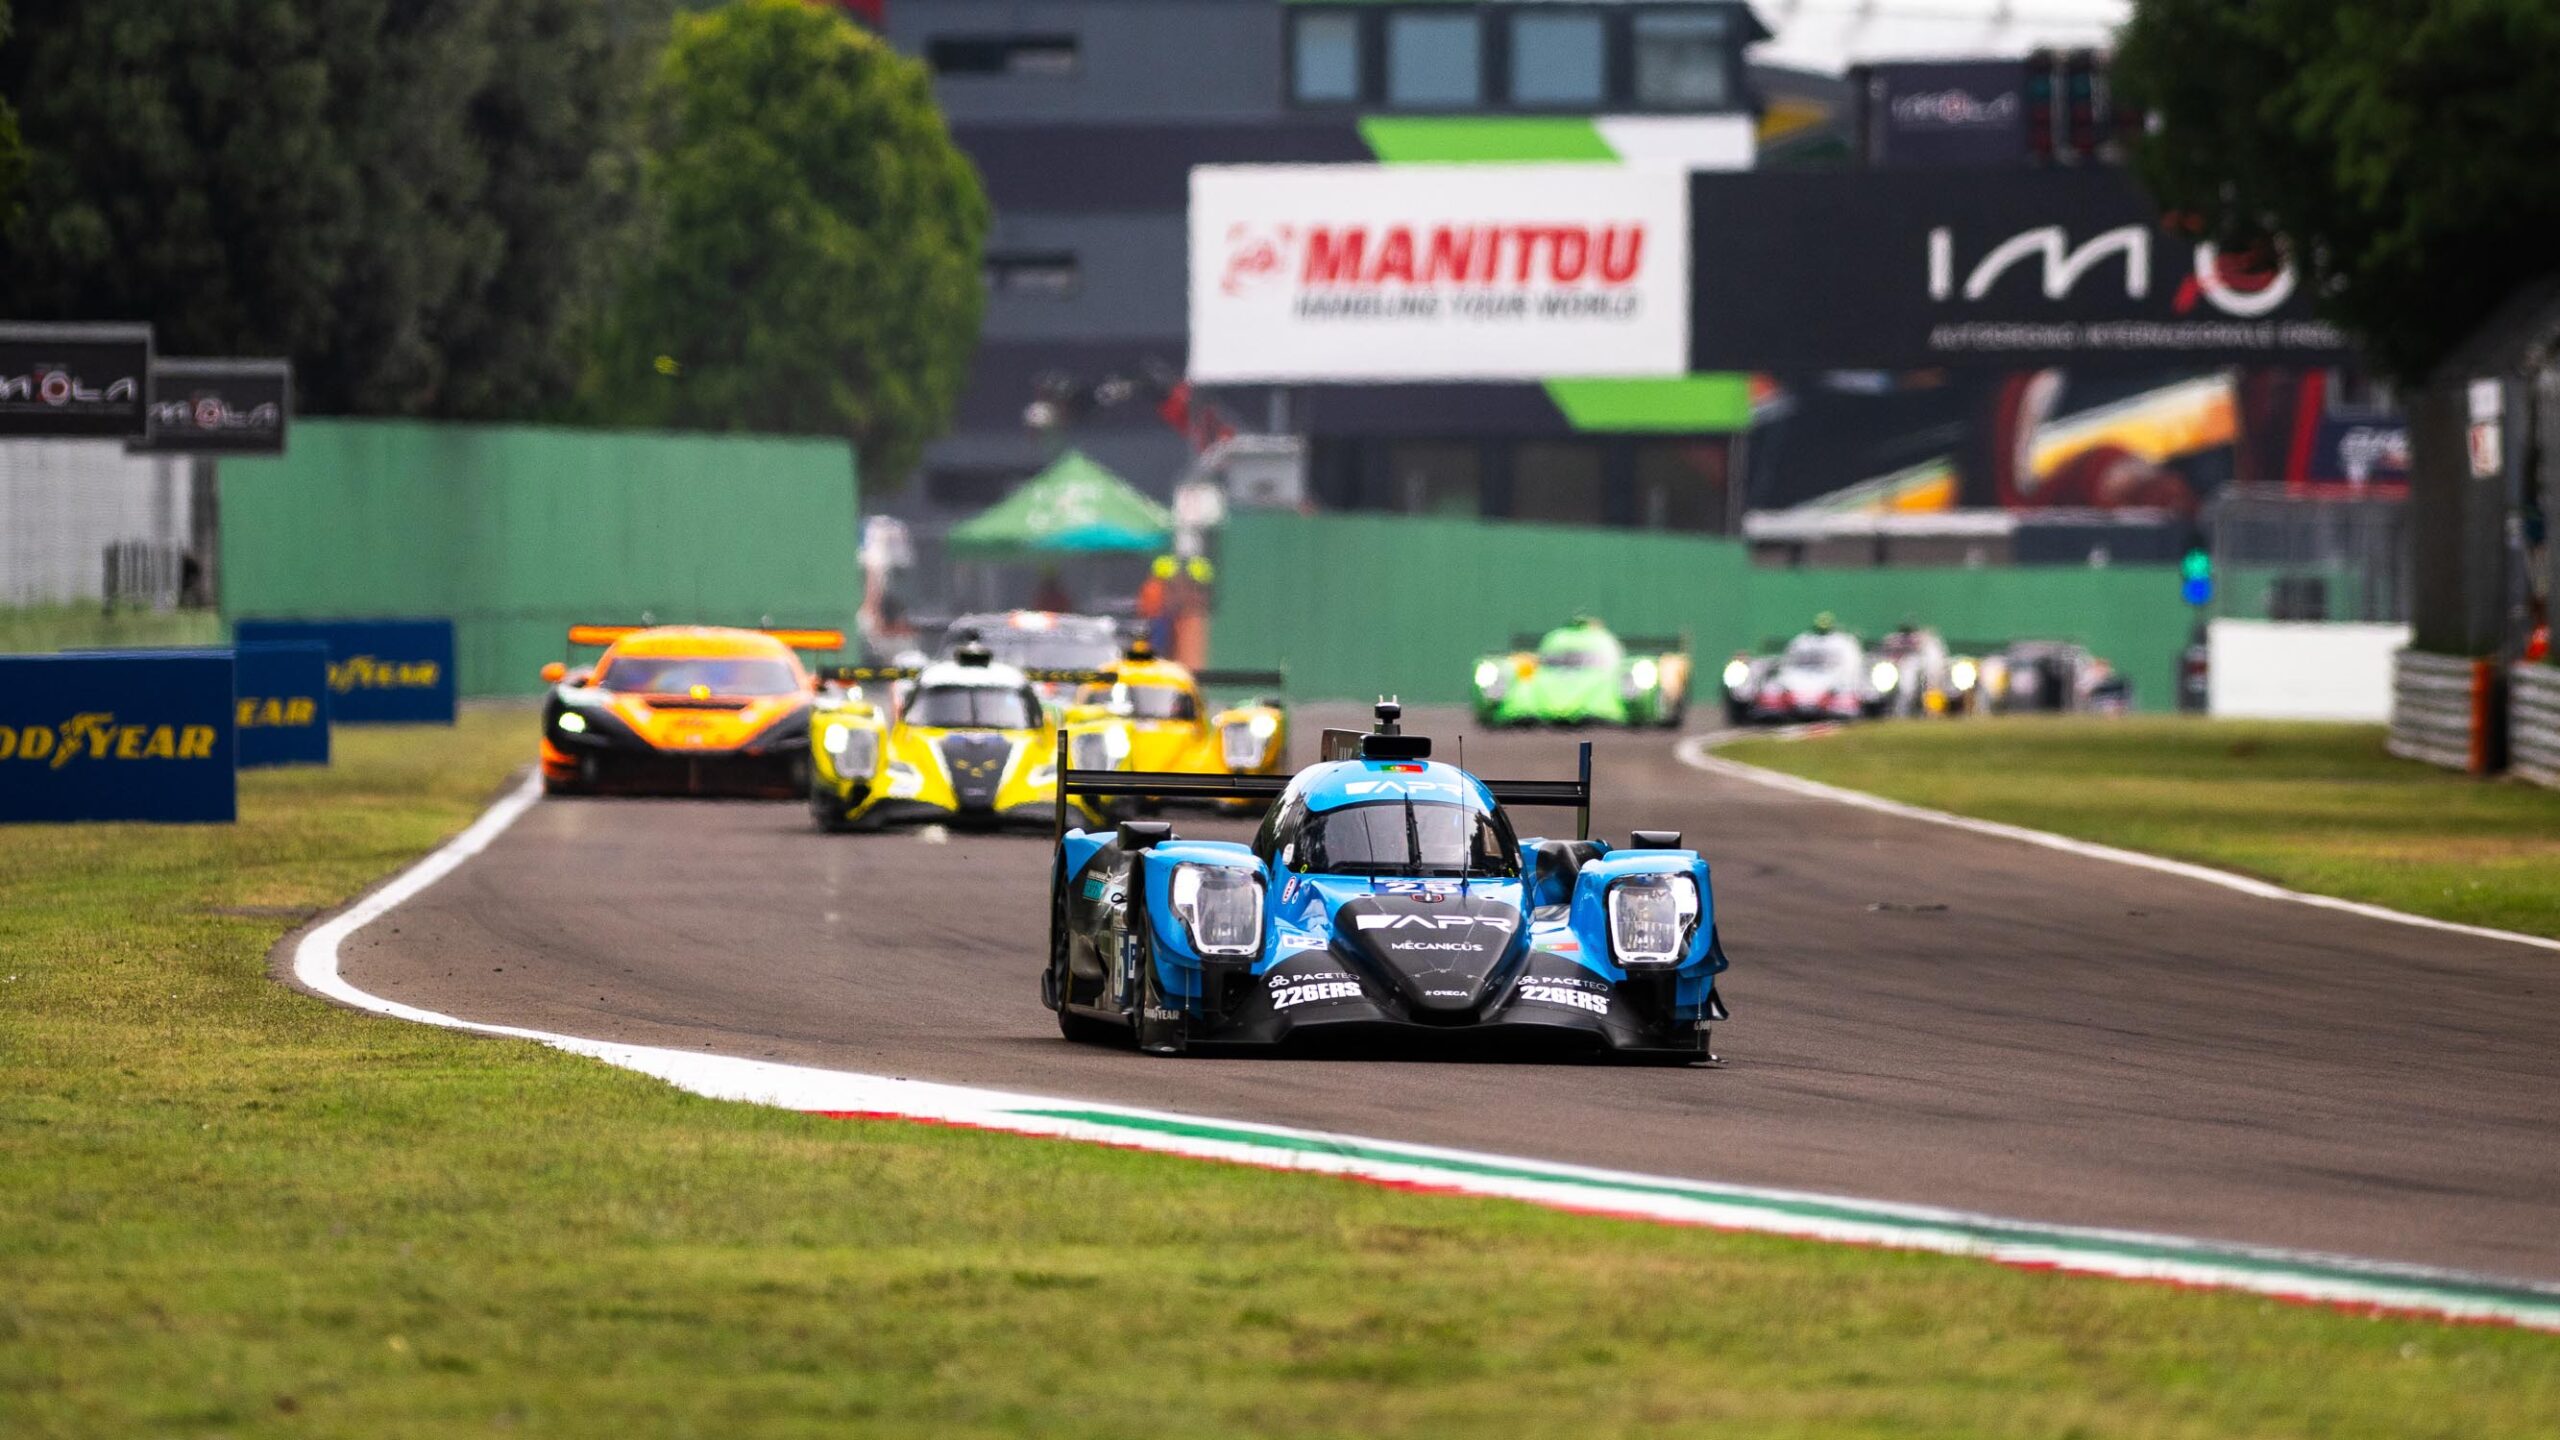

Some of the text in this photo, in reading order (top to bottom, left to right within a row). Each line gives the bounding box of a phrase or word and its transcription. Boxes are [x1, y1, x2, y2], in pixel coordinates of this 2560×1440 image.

[1303, 225, 1642, 284] MANITOU
[1386, 882, 1459, 894] 25
[1392, 914, 1512, 933] APR
[1271, 981, 1362, 1010] 226ERS
[1520, 985, 1609, 1015] 226ERS
